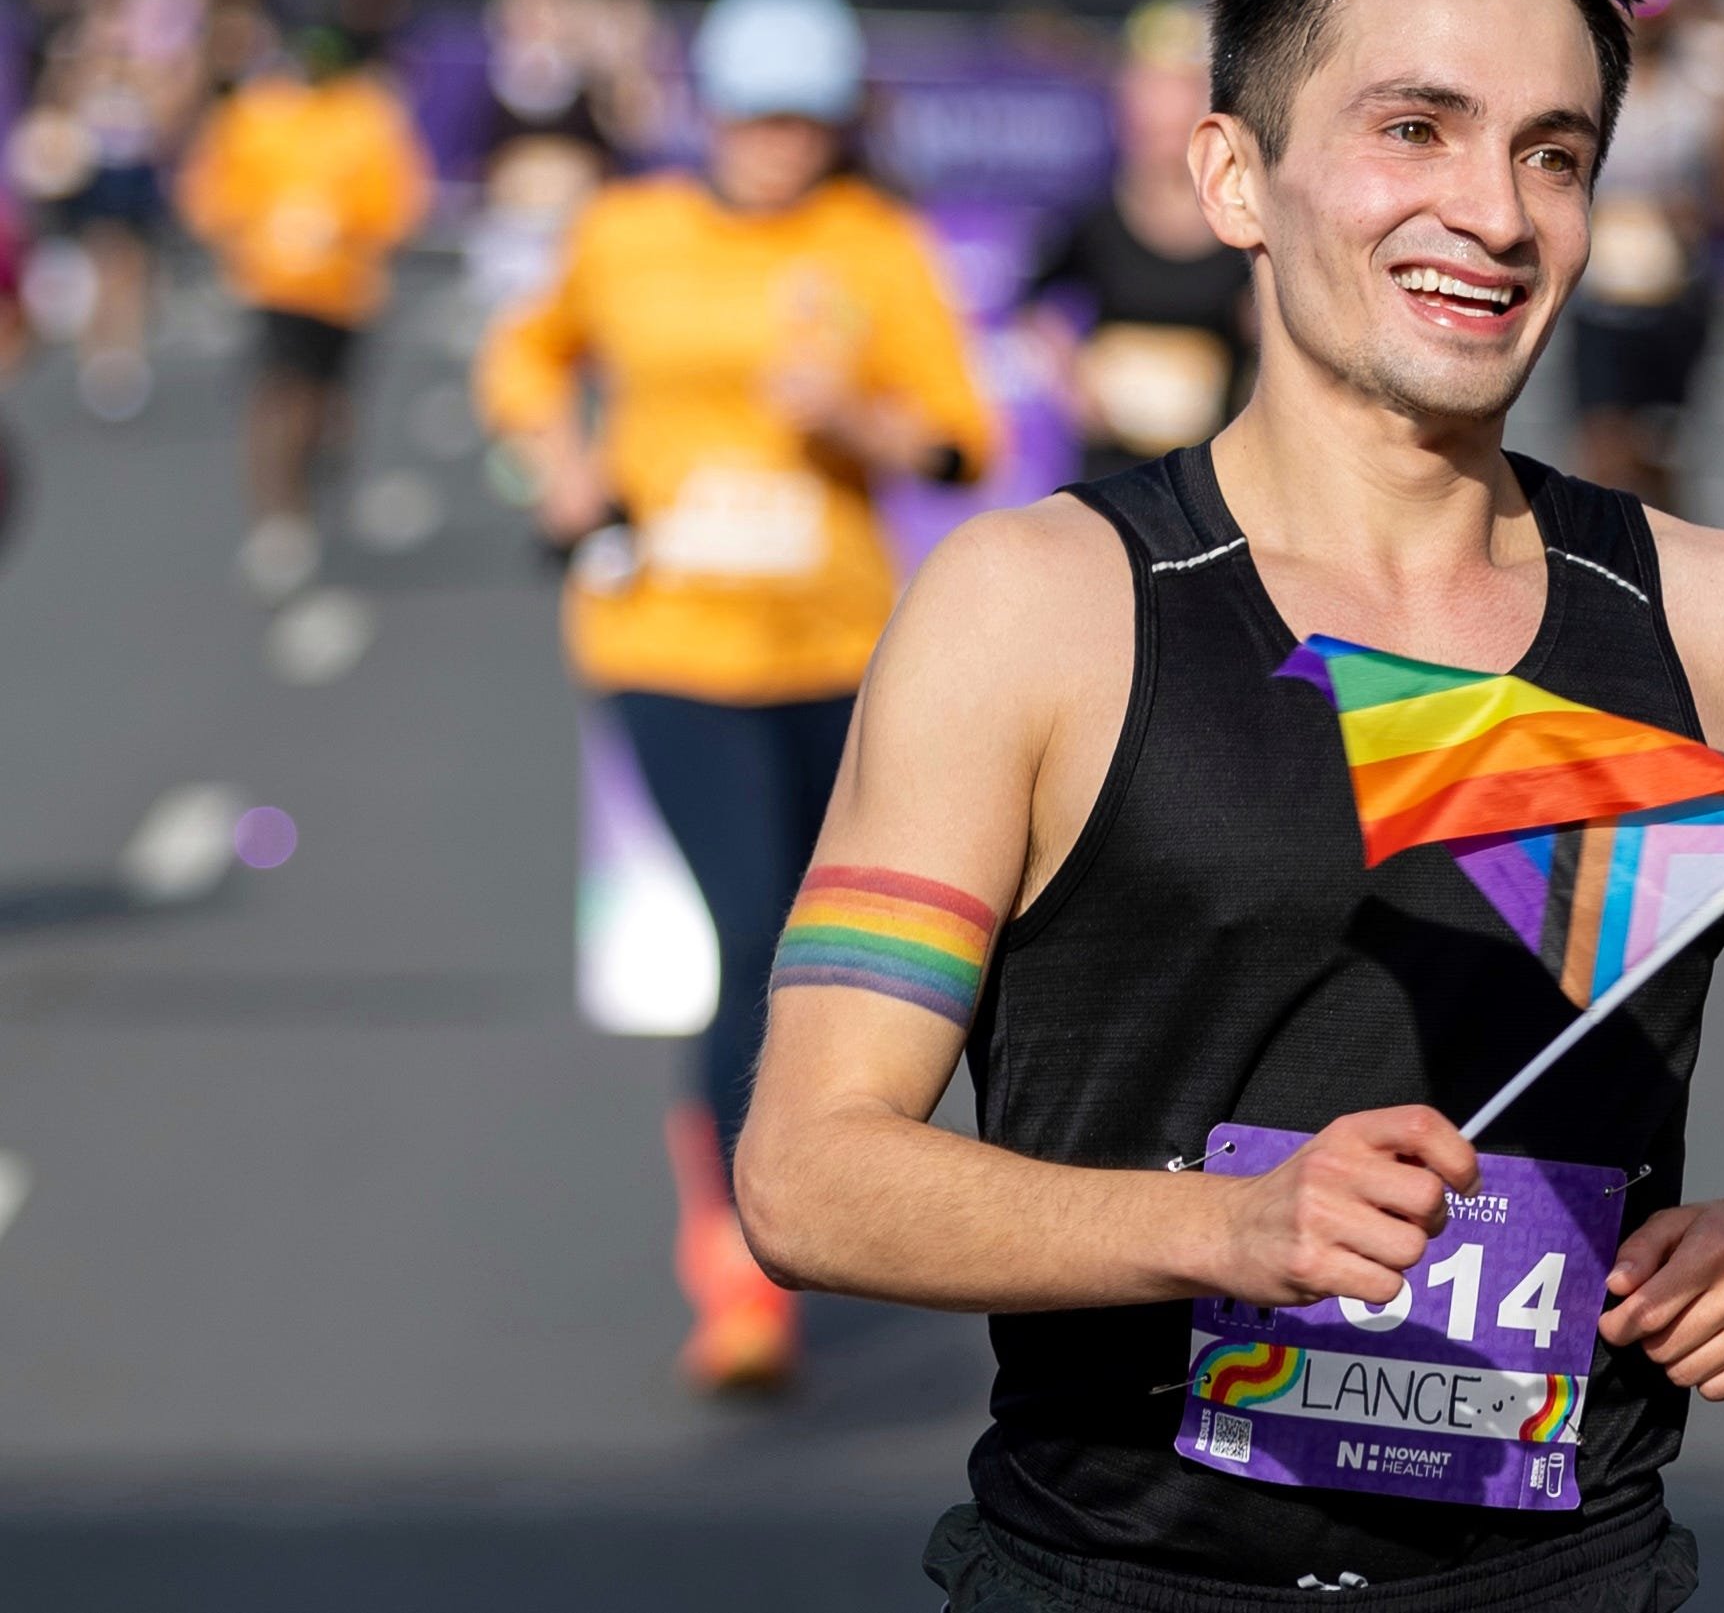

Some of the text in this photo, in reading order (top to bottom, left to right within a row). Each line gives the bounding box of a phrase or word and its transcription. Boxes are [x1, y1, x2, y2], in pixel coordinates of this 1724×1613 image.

[1445, 1192, 1508, 1210] RLOTTE
[1447, 1206, 1506, 1224] ATHON
[1384, 1446, 1452, 1465] NOVANT
[1382, 1460, 1444, 1479] HEALTH
